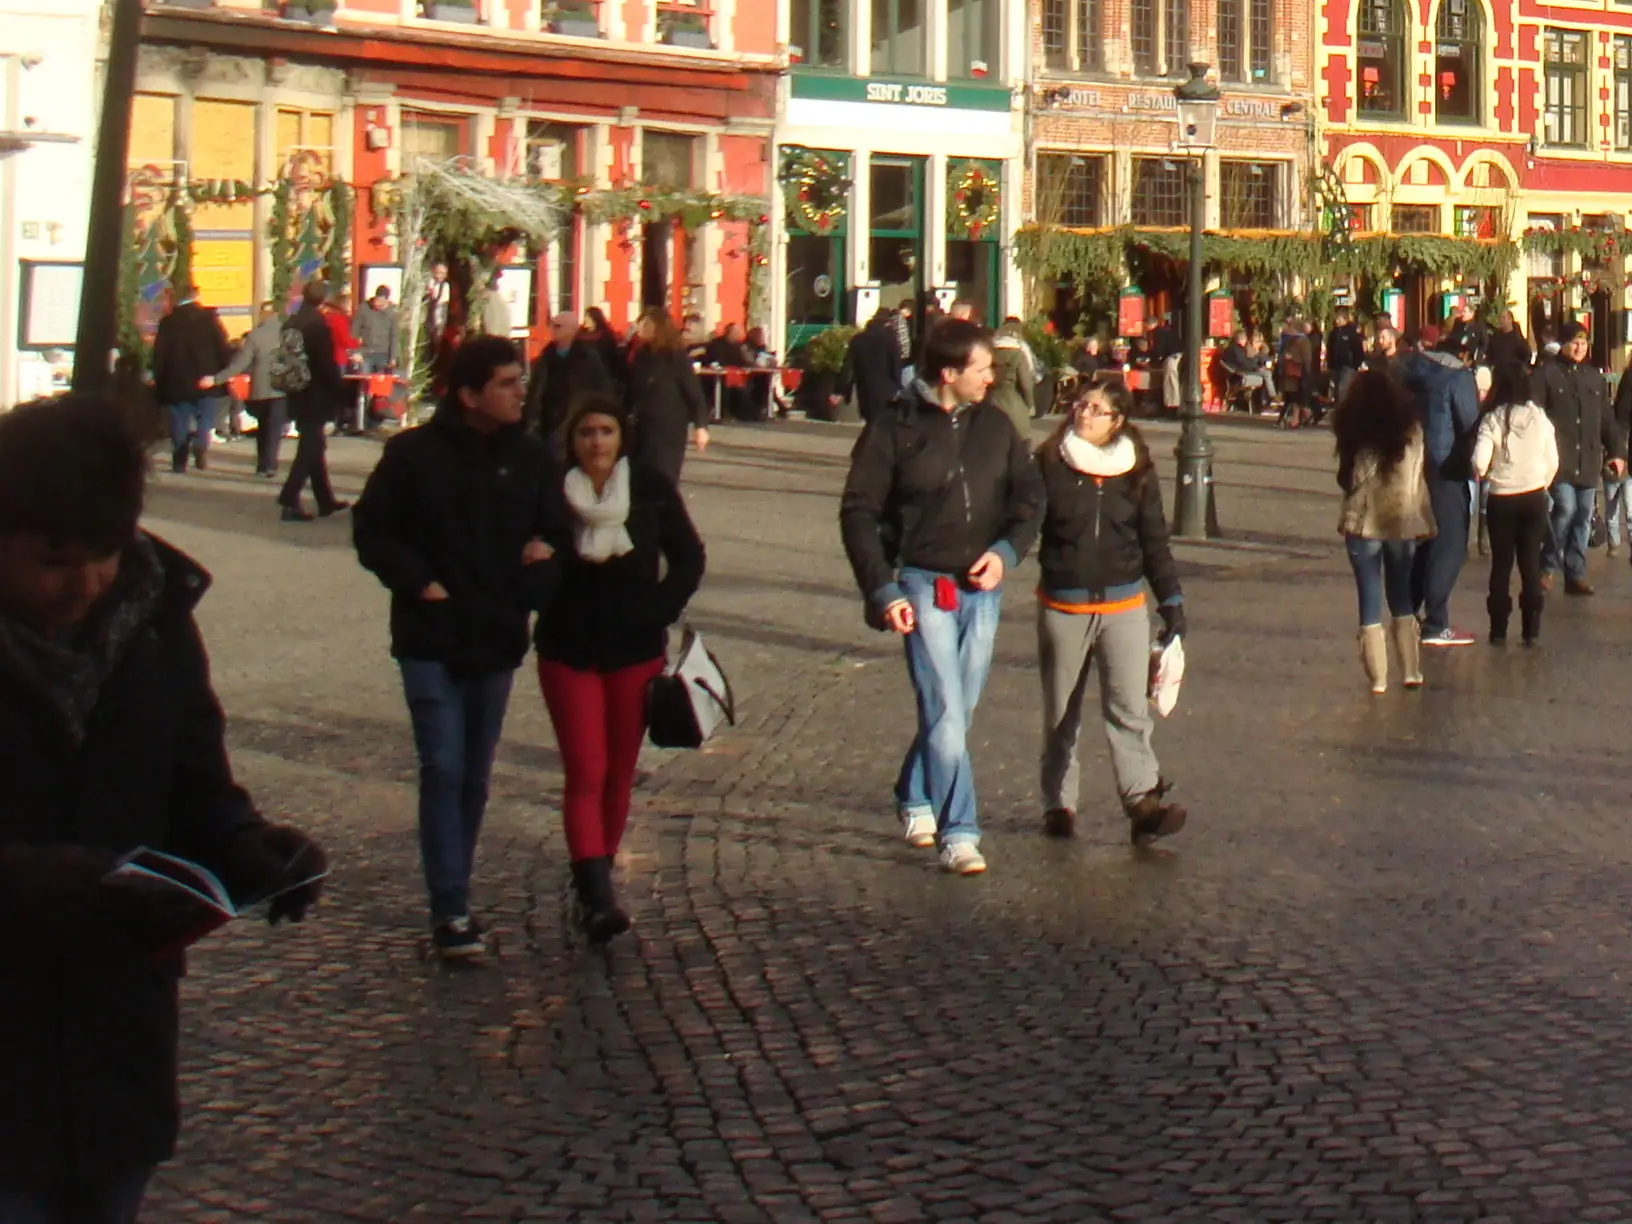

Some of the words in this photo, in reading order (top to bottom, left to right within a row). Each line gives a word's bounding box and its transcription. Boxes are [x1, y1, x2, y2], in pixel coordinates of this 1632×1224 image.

[866, 82, 902, 102] SINT
[904, 85, 947, 105] JORIS
[1128, 92, 1178, 110] RESTAU
[1226, 99, 1277, 118] CENTRAL
